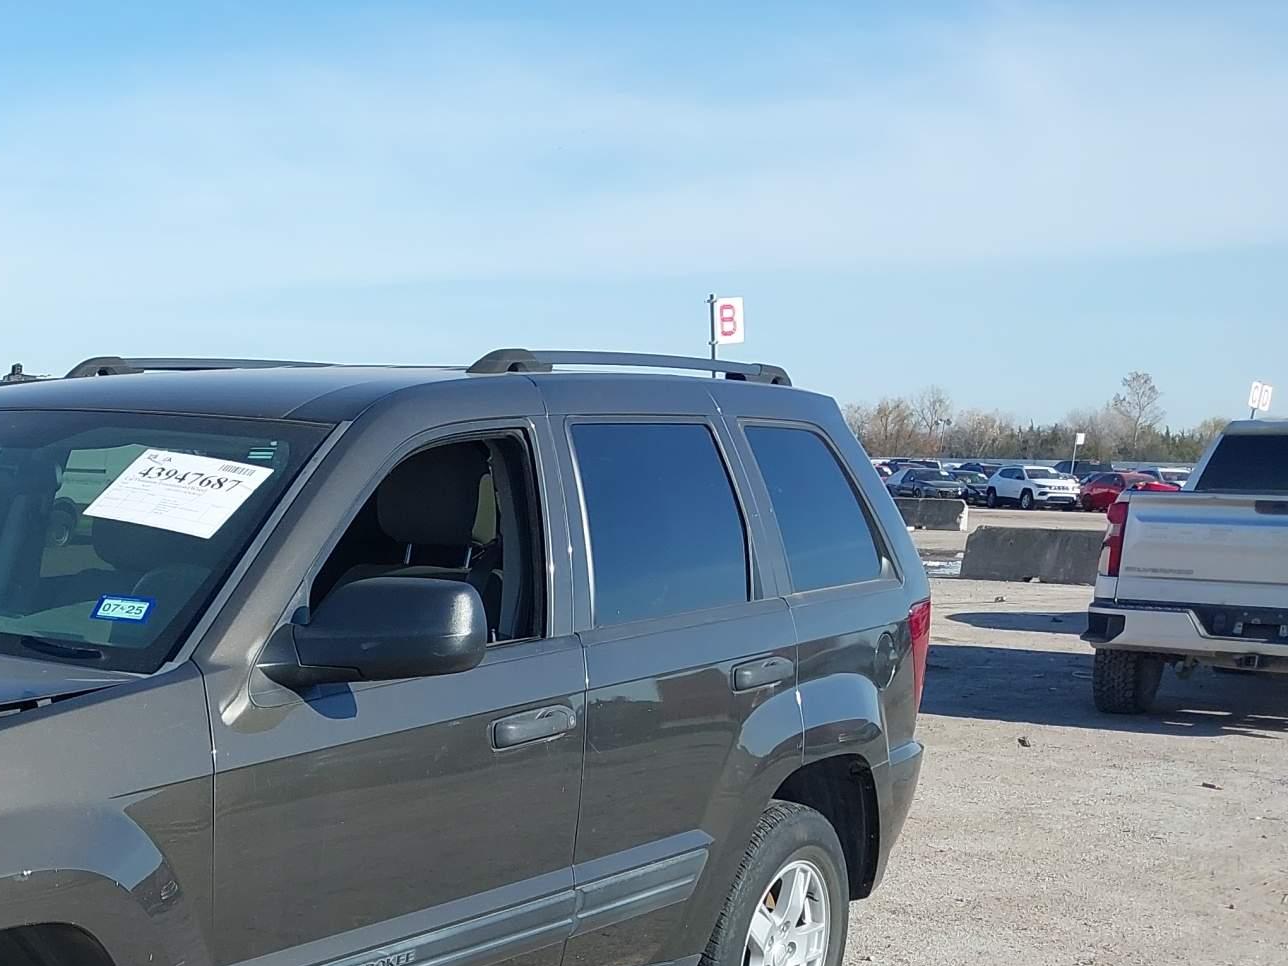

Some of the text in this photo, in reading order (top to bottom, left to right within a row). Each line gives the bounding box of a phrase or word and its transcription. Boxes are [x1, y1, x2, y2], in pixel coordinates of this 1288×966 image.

[719, 304, 737, 336] B
[138, 465, 242, 492] 43947687
[102, 603, 145, 615] 07 25
